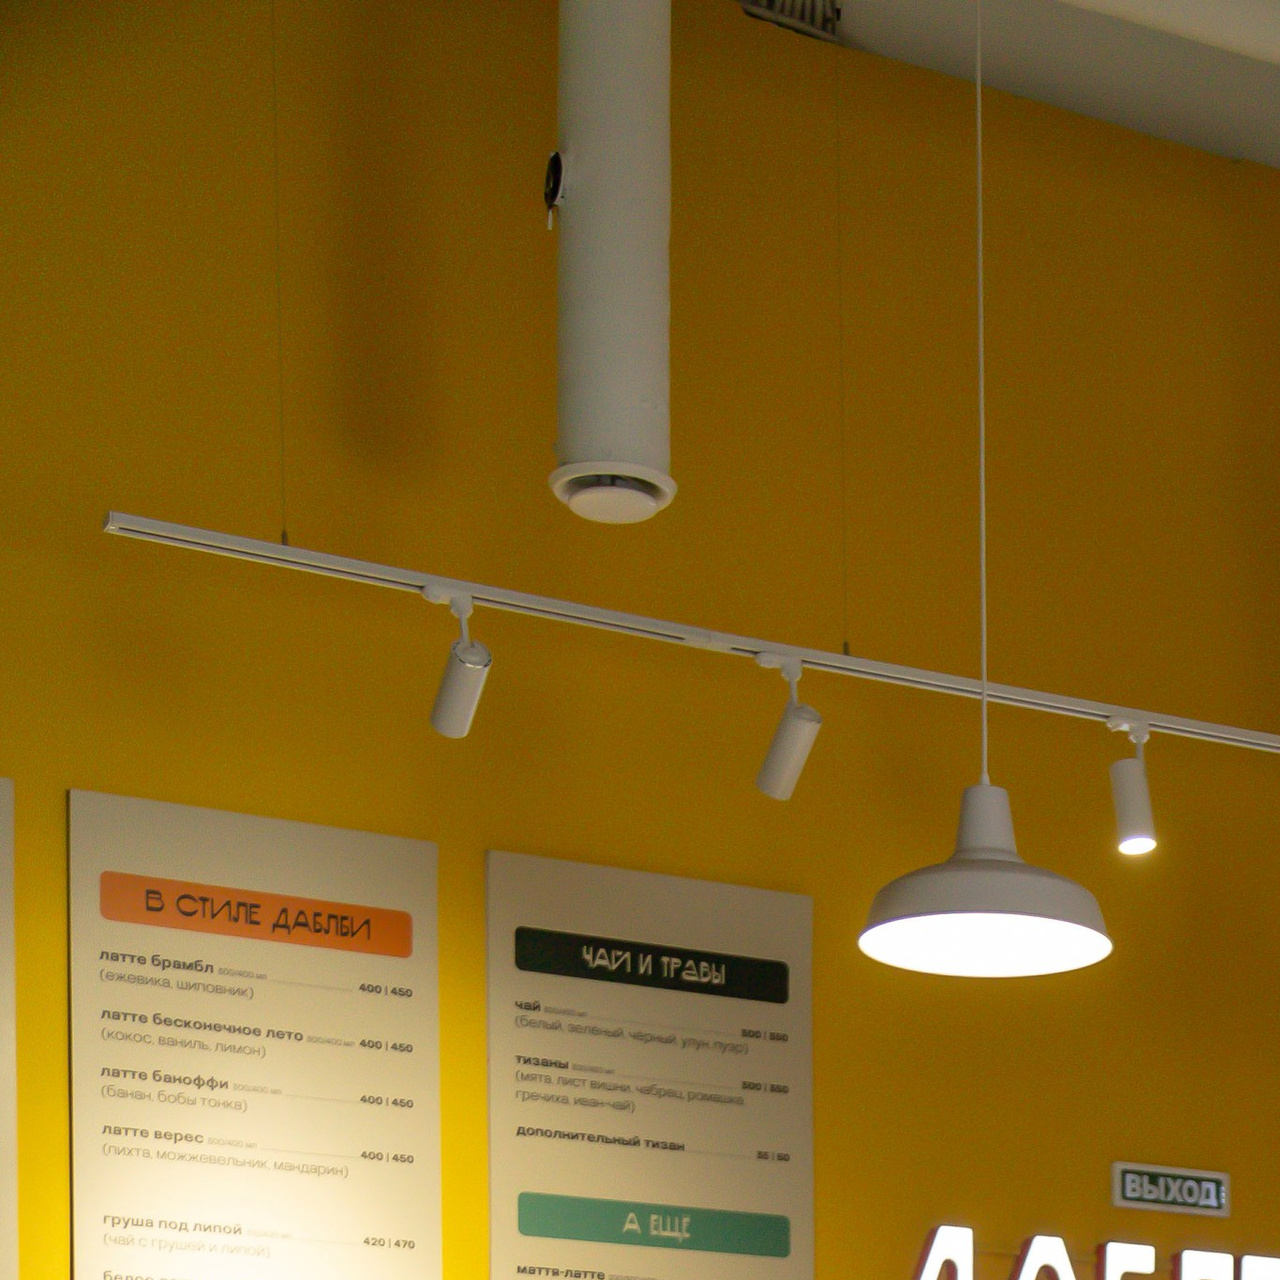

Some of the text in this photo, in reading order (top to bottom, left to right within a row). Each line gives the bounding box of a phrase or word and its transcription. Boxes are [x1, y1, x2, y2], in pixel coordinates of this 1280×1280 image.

[145, 889, 371, 940] В СТИЛЕ ДАБЛБИ
[99, 950, 147, 966] латте
[151, 954, 214, 973] брамбл
[358, 983, 382, 995] 400
[390, 986, 413, 998] 450
[582, 945, 726, 985] ЧАЙ И ТРАВЫ
[176, 980, 254, 1000] шиповник)
[515, 1000, 541, 1012] чай
[100, 1009, 148, 1024] латте
[152, 1012, 262, 1037] бесконечное
[266, 1028, 304, 1042] лето
[359, 1038, 382, 1049] 400
[390, 1042, 413, 1053] 450
[214, 1041, 267, 1059] лимон)
[515, 1054, 569, 1070] тизаны
[100, 1066, 148, 1081] латте
[152, 1070, 229, 1090] баноффи
[360, 1094, 383, 1105] 400
[392, 1097, 414, 1109] 450
[157, 1089, 197, 1106] бобы
[102, 1124, 149, 1138] латте
[154, 1129, 204, 1144] верес
[360, 1150, 384, 1161] 400
[392, 1153, 414, 1164] 450
[516, 1126, 641, 1147] дополнительный
[644, 1138, 685, 1151] тизан
[1123, 1172, 1219, 1209] ВЫХОД
[103, 1214, 154, 1229] груша
[158, 1219, 189, 1233] под
[192, 1223, 242, 1235] липой
[363, 1237, 385, 1248] 420
[394, 1239, 415, 1250] 470
[623, 1212, 642, 1234] А
